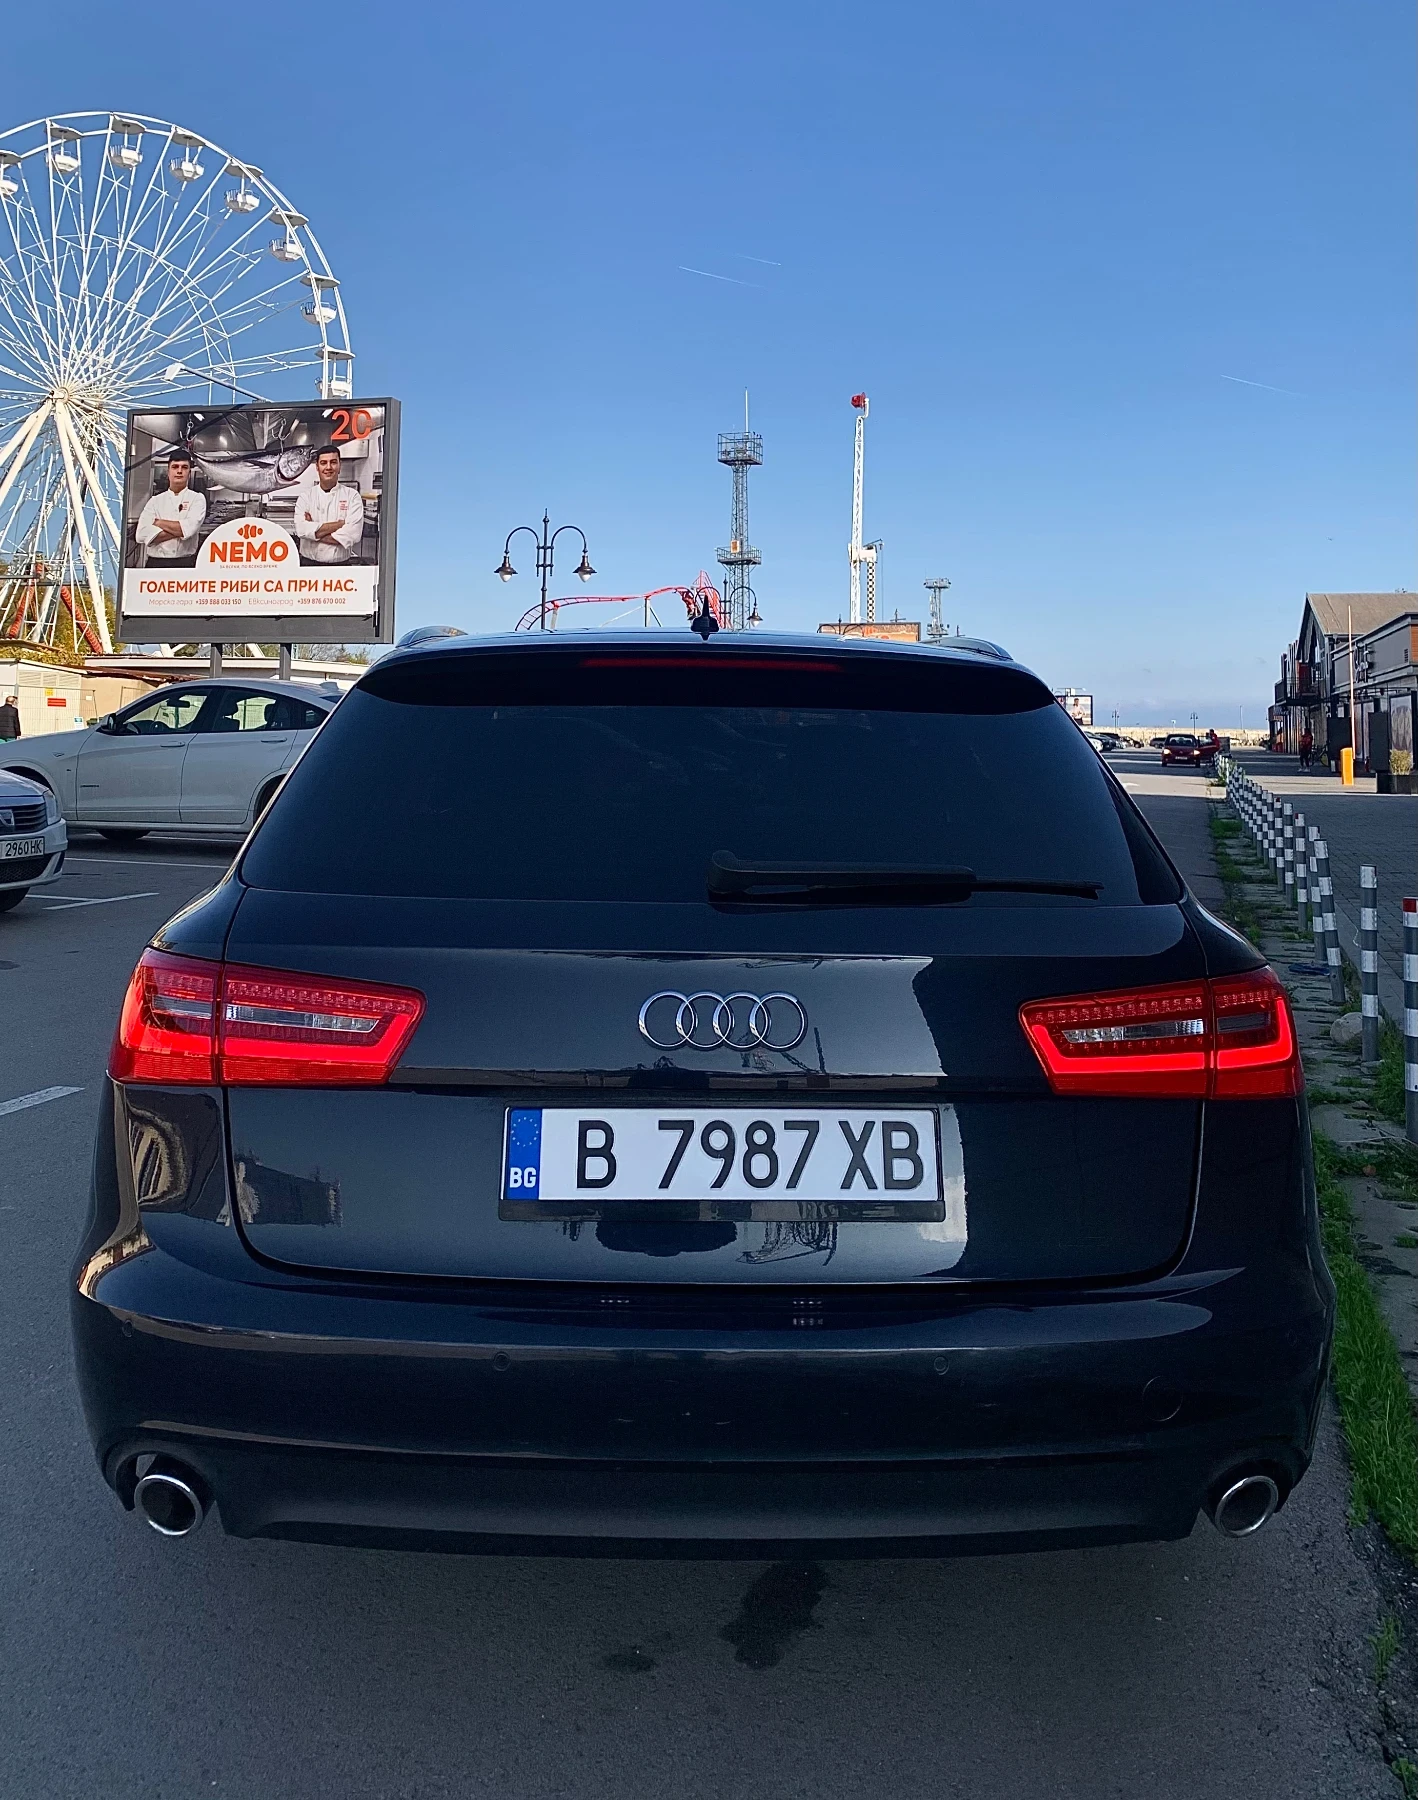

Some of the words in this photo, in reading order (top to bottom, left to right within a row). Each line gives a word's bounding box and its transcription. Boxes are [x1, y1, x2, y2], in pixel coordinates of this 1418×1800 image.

[209, 540, 289, 562] NEMO
[139, 580, 217, 593] ГОЛЕМИТЕ
[220, 580, 260, 593] РИБИ
[263, 579, 284, 593] СА
[287, 579, 319, 593] ПРИ
[322, 579, 358, 592] НАС.
[297, 597, 311, 605] +359
[576, 1120, 617, 1189] B
[657, 1120, 820, 1189] 7987
[838, 1120, 925, 1190] XB
[509, 1167, 537, 1188] BG
